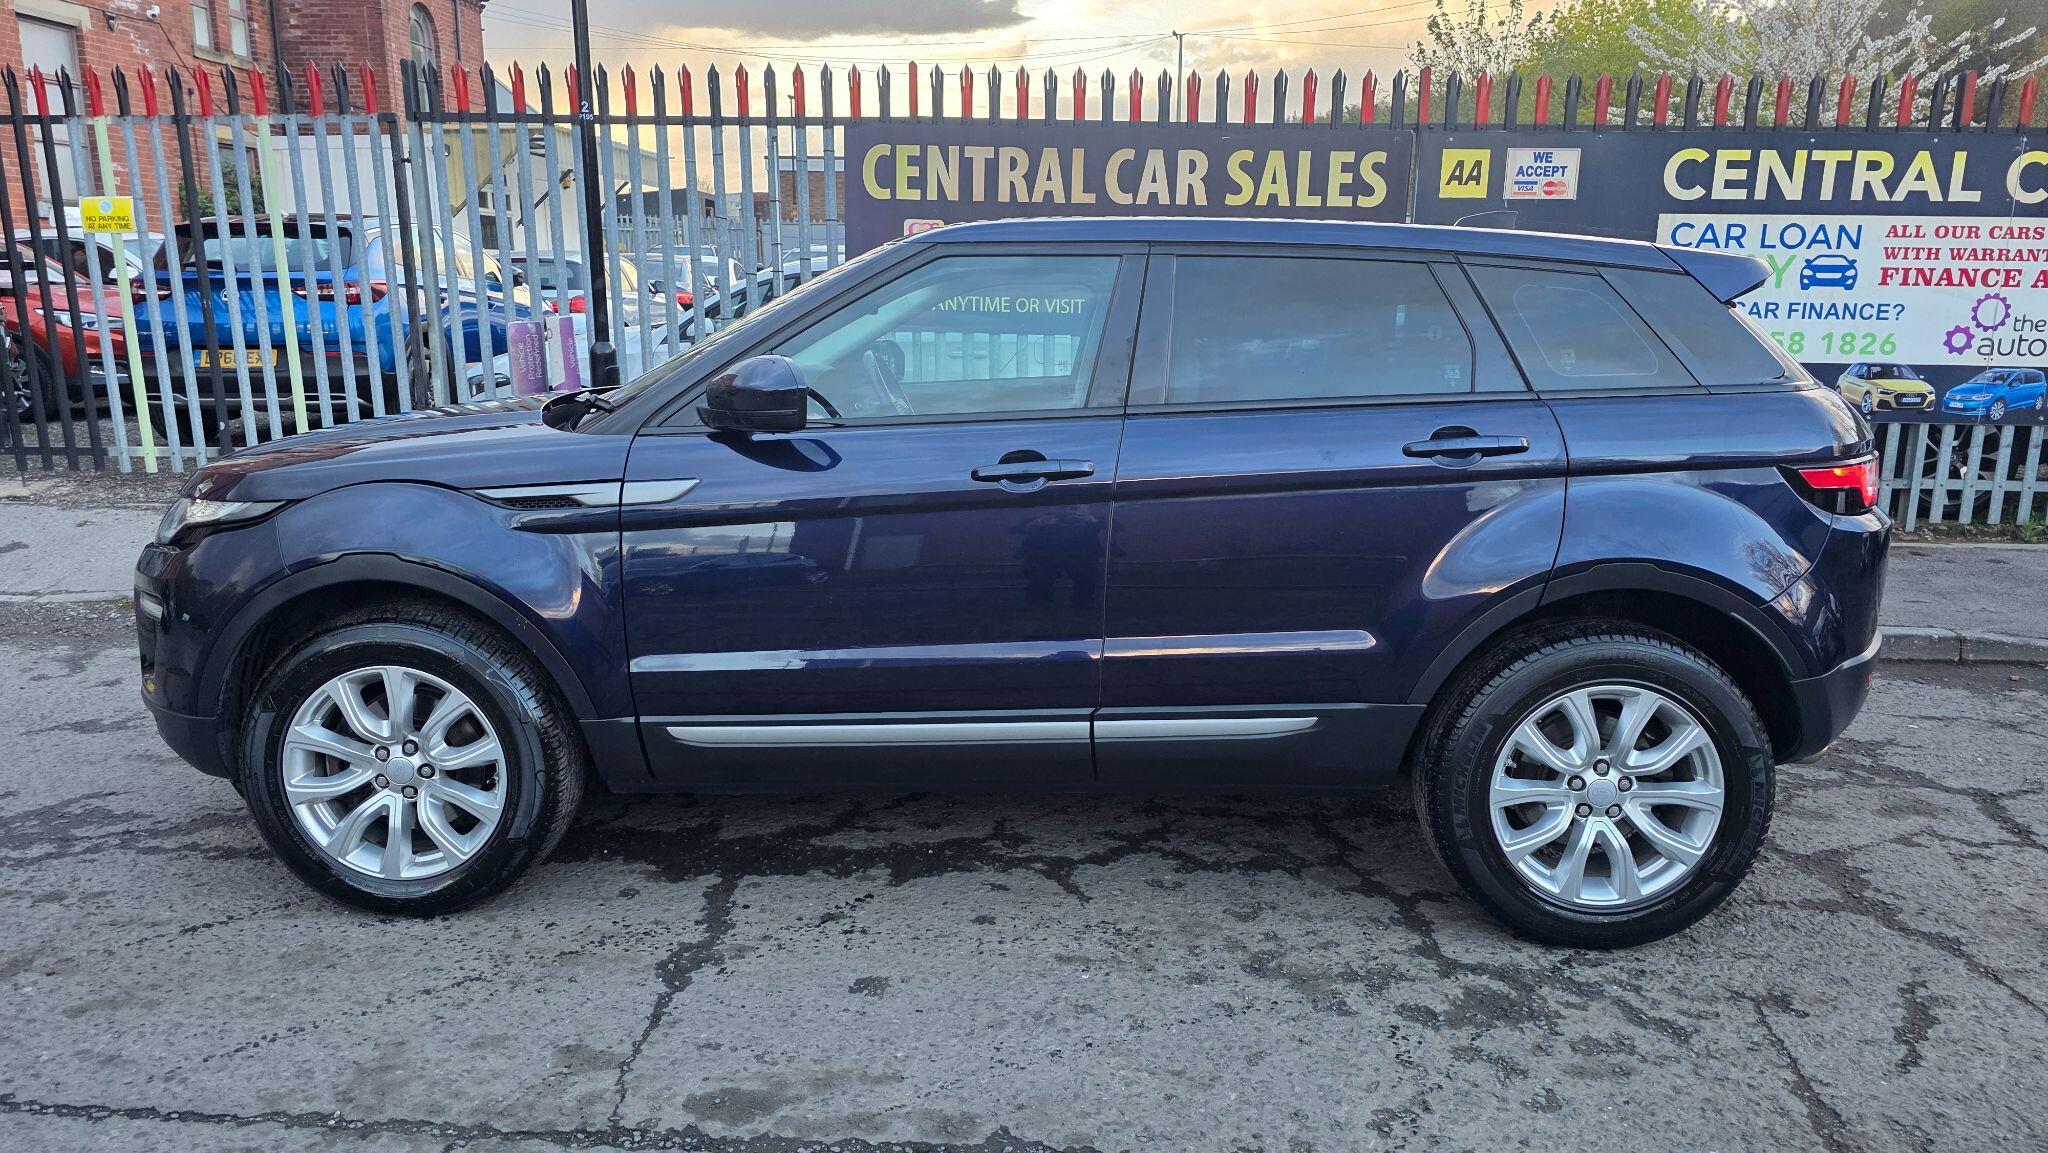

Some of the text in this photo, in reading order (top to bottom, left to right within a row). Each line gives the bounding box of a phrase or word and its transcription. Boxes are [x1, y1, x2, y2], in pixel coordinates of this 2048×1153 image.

[581, 101, 590, 113] 2
[1533, 151, 1554, 164] WE
[862, 144, 1389, 208] CENTRAL CAR SALES
[1445, 159, 1483, 186] AA
[1516, 165, 1568, 178] ACCEPT
[1663, 147, 1982, 202] CENTRAL
[1670, 222, 1863, 249] CAR LOAN
[1885, 224, 2046, 240] ALL OUR CARS
[1883, 246, 1942, 260] WITH
[1878, 267, 2023, 288] FINANCE
[1016, 297, 1040, 313] OR
[1044, 298, 1086, 314] VISIT
[1737, 301, 1906, 321] AR FINANCE?
[2013, 314, 2047, 332] the
[1821, 331, 1898, 355] 1826
[1976, 333, 2048, 357] auto
[517, 342, 528, 373] Vehicle
[525, 334, 535, 379] Protection
[531, 334, 543, 378] Redefined
